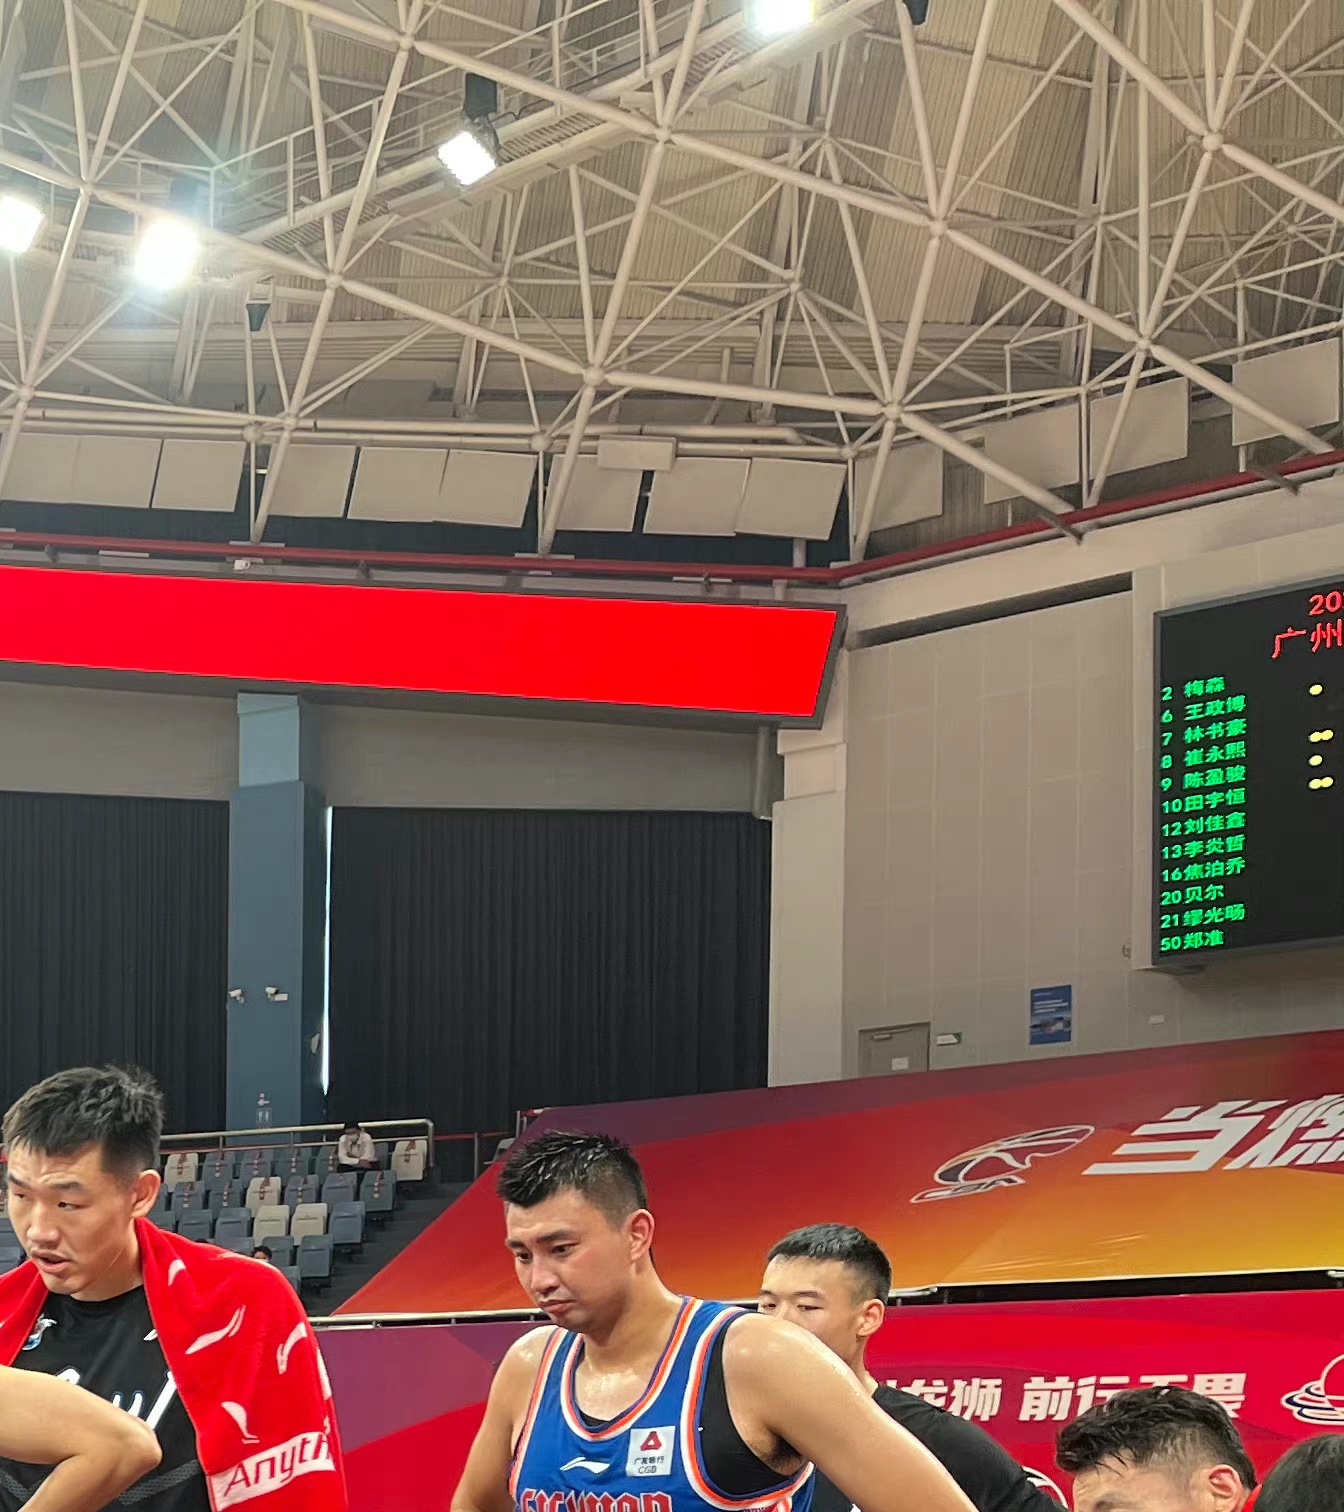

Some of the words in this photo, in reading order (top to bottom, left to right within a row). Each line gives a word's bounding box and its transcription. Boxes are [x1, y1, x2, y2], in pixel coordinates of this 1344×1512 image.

[1162, 686, 1173, 701] 2
[1161, 709, 1173, 723] 6
[1162, 732, 1173, 746] 7
[1161, 755, 1173, 769] 8
[1161, 777, 1173, 792] 9
[1162, 798, 1183, 814] 10
[1161, 821, 1183, 837] 12
[1161, 844, 1183, 859] 13
[1161, 867, 1183, 882] 16
[1160, 890, 1183, 906] 20
[1183, 884, 1225, 904] 贝尔
[1160, 913, 1180, 929] 21
[1160, 936, 1182, 951] 50
